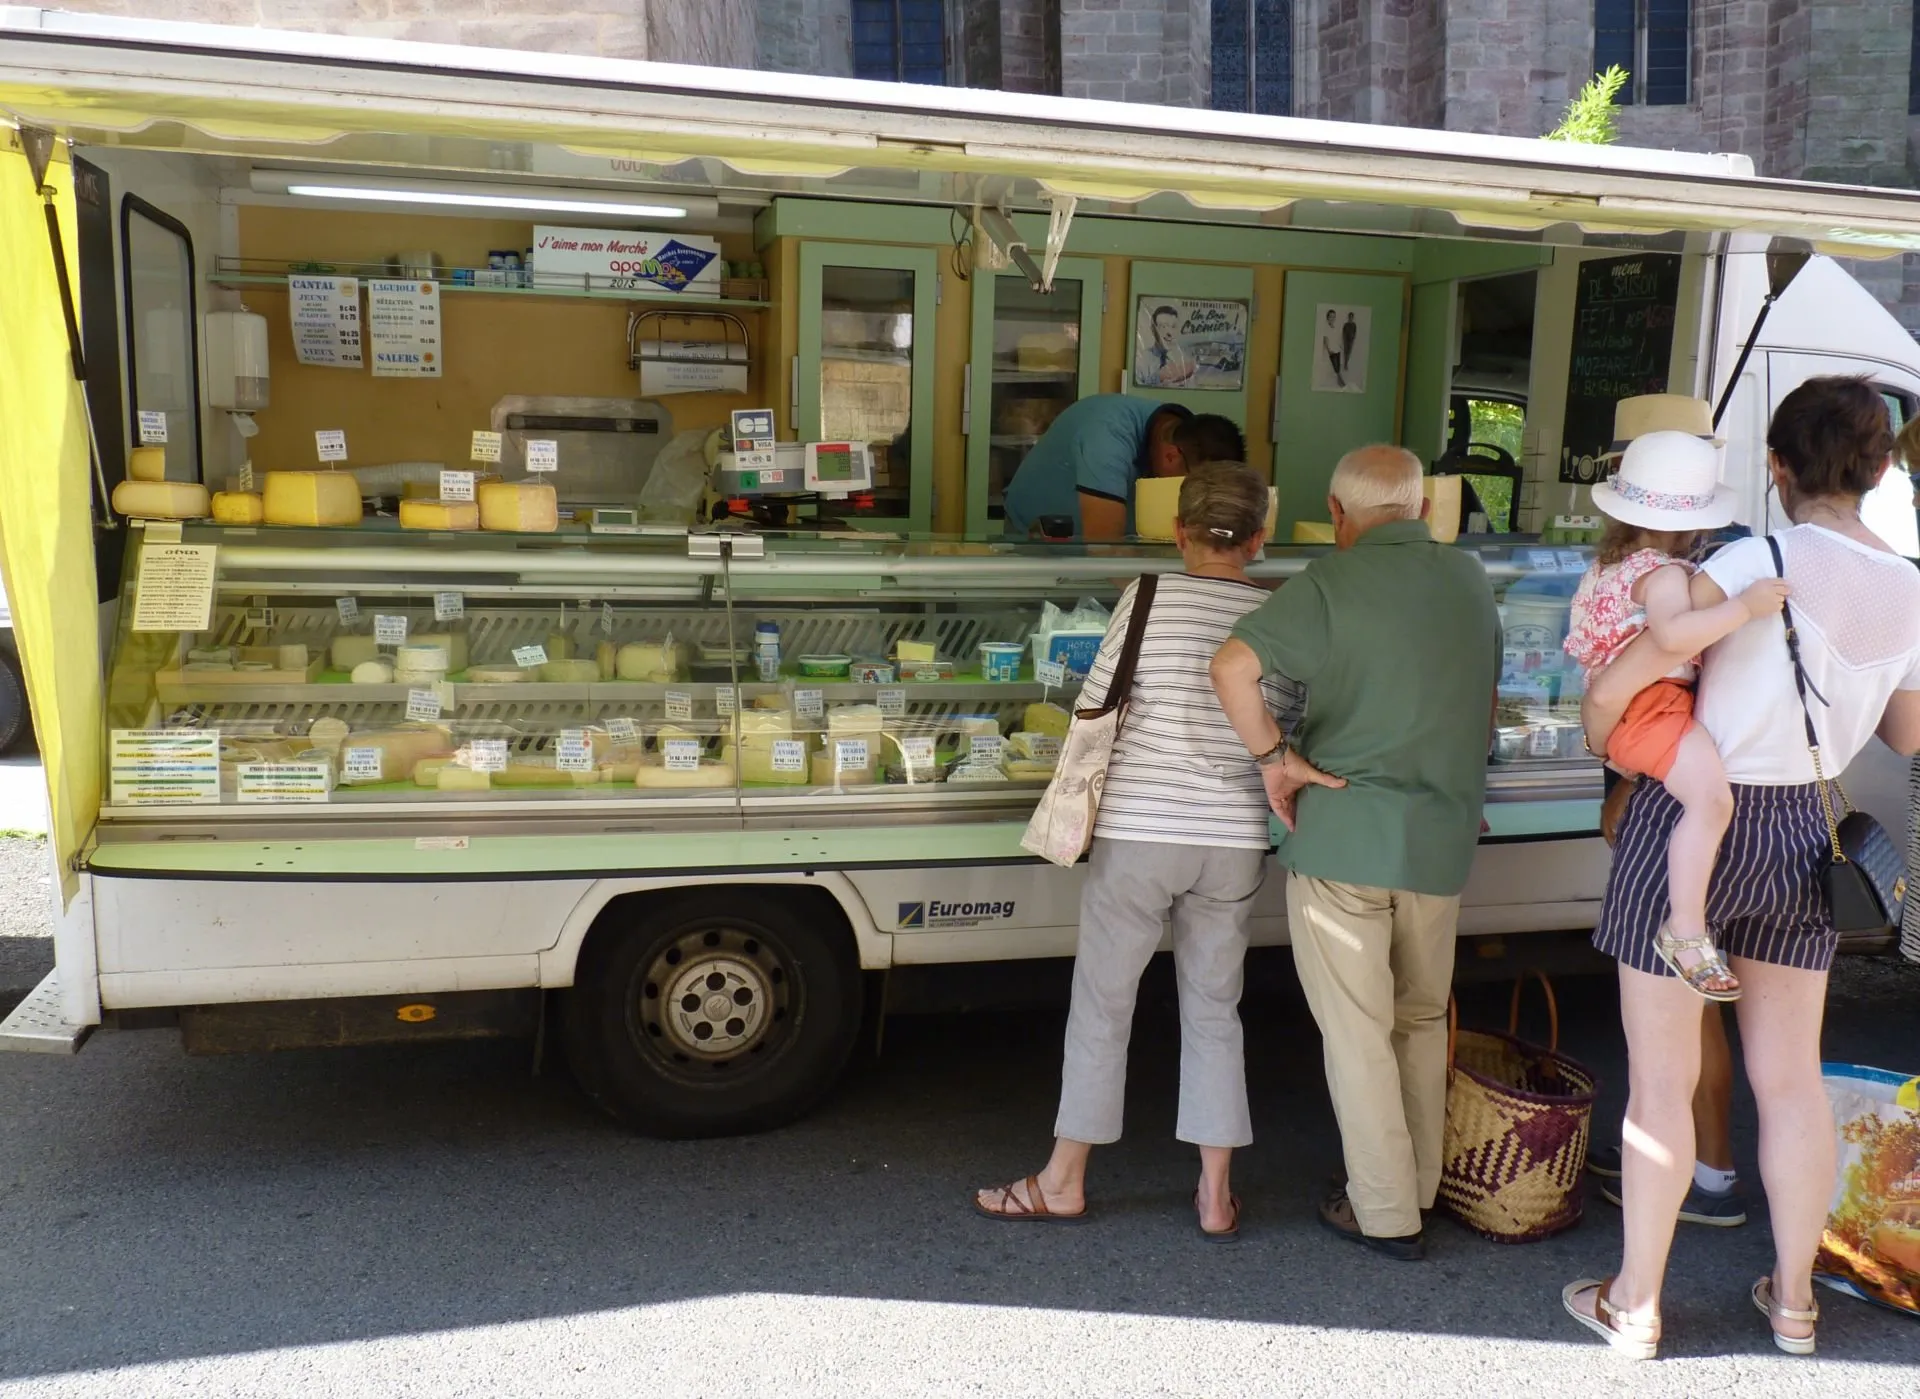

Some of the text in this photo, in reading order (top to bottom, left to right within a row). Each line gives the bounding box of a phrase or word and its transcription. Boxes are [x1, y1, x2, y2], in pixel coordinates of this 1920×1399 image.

[580, 242, 604, 252] mon
[606, 240, 648, 255] Marché
[1611, 262, 1643, 277] menu
[292, 280, 336, 290] CANTAL
[372, 283, 417, 292] LAGUIOLE
[1588, 271, 1658, 298] DE SAISON
[1190, 309, 1227, 321] Un Bon
[1580, 305, 1615, 333] FETA
[303, 348, 335, 356] VIEUX
[377, 352, 420, 363] SALERS
[1575, 355, 1654, 377] MOZZARELLA
[928, 901, 1015, 918] Euromag
